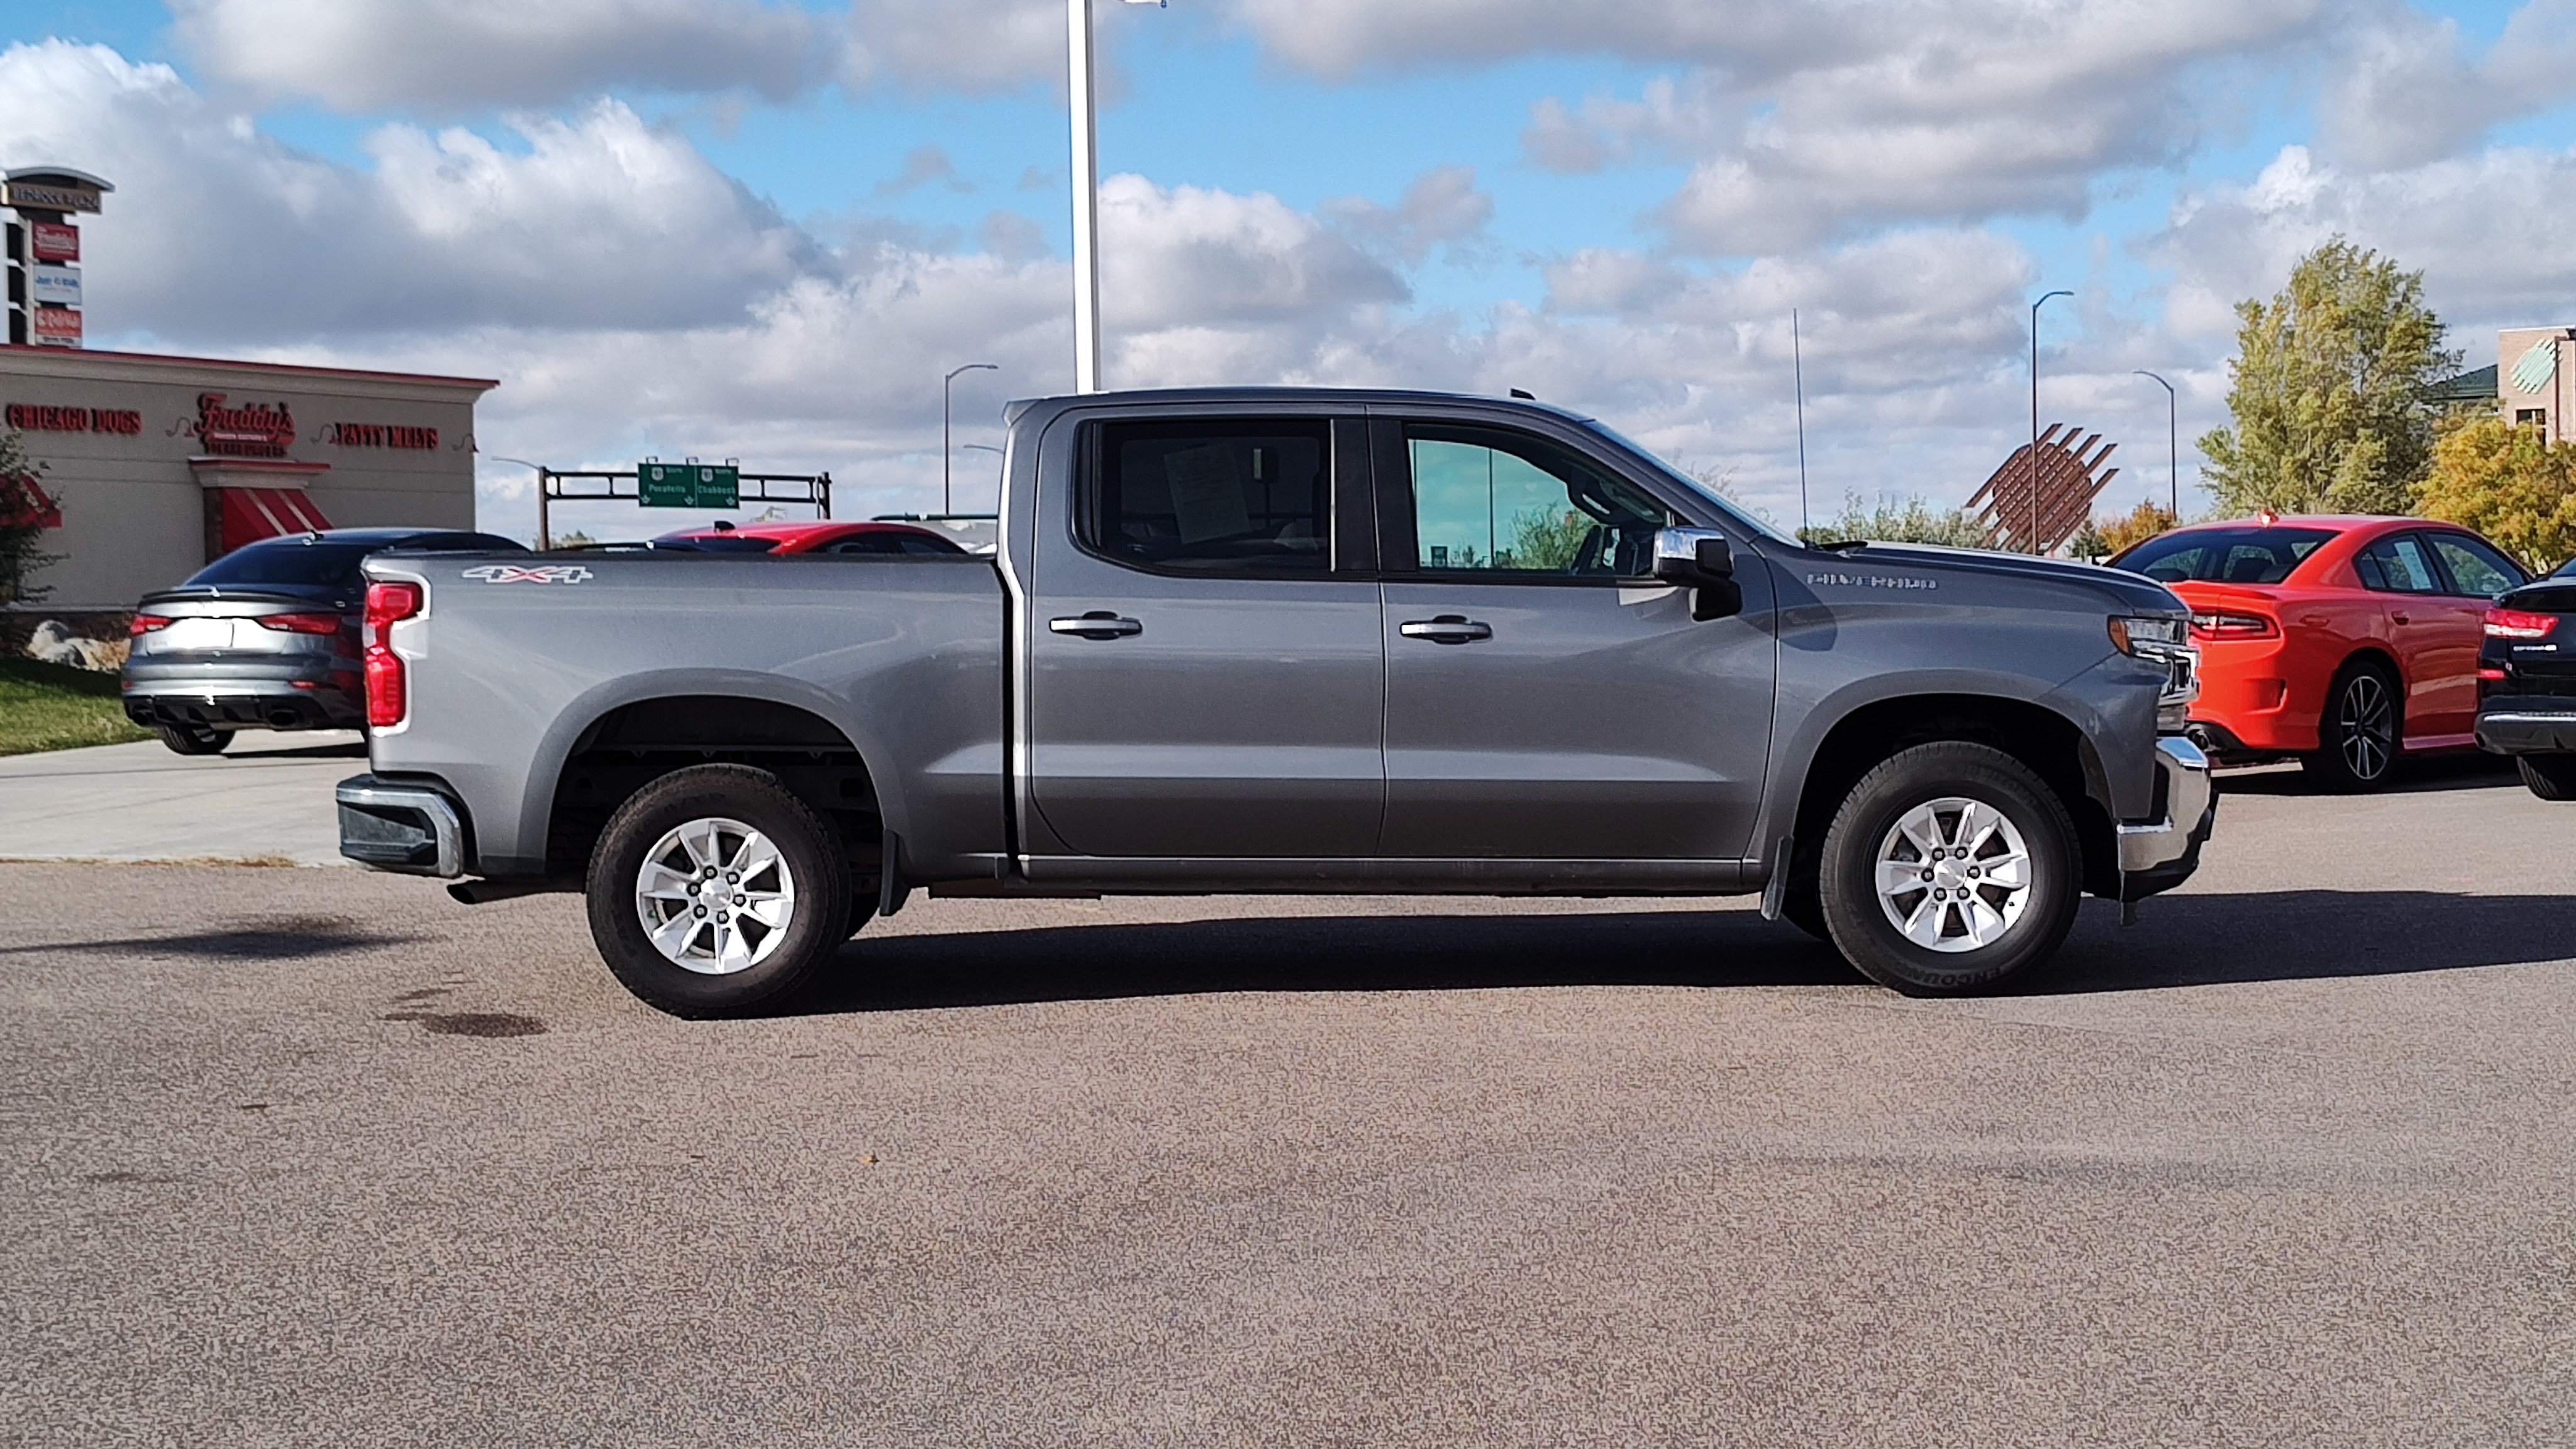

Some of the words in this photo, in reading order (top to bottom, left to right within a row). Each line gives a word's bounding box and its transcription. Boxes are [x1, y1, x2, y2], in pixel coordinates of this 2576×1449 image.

[6, 404, 91, 431] CHICAGO
[91, 408, 142, 435] DOGS
[194, 393, 296, 440] Freddy's
[335, 423, 385, 447] PATTY
[387, 426, 439, 450] MELTS
